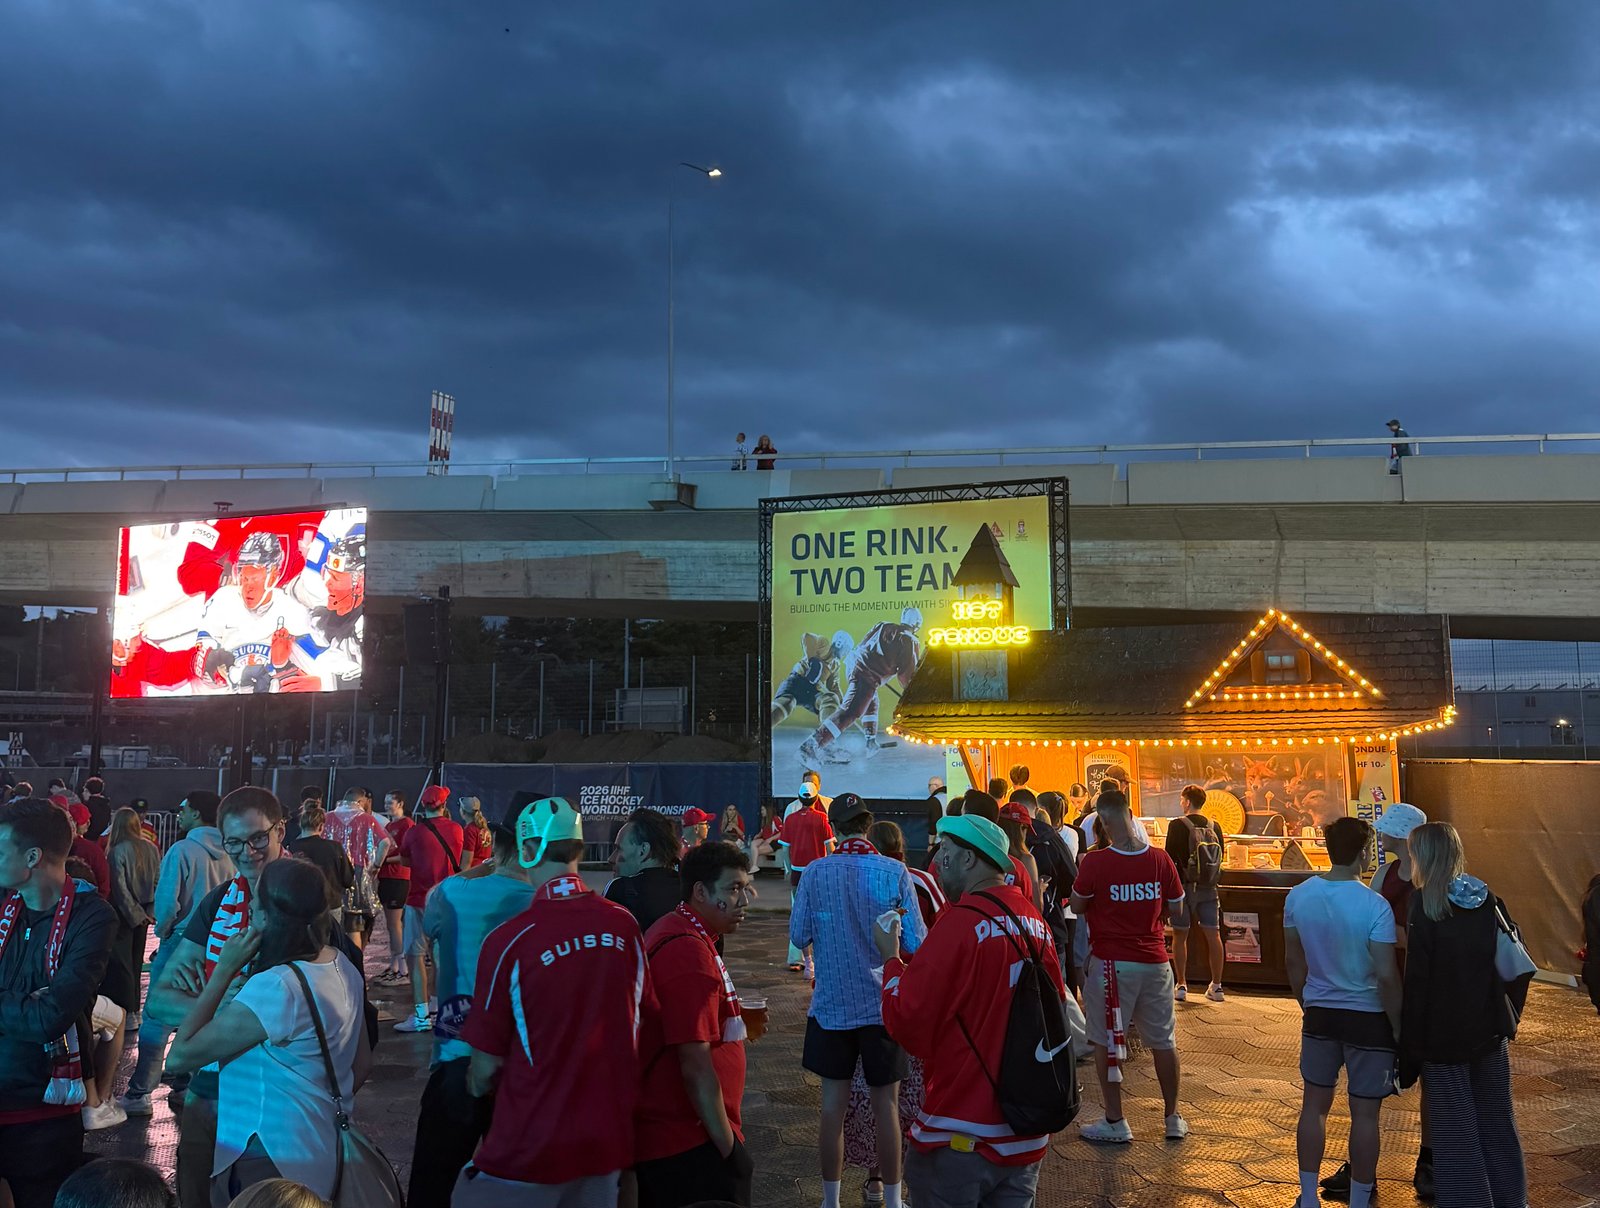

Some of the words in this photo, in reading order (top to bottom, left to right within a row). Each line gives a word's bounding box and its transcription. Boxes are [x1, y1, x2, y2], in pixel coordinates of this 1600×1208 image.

[791, 531, 856, 561] ONE
[866, 525, 959, 557] RINK.
[790, 566, 865, 597] TWO
[874, 562, 956, 593] TEAM
[790, 603, 831, 614] BUILDING
[832, 602, 850, 612] THE
[852, 600, 908, 611] MOMENTUM
[911, 599, 936, 609] WITH
[952, 600, 1003, 620] HOT
[928, 625, 1031, 646] FONDUE
[232, 644, 271, 659] SUOMI
[1354, 745, 1387, 753] ONDUE
[580, 785, 610, 795] 2026
[610, 785, 631, 795] IIHF
[580, 795, 600, 805] ICE
[600, 795, 645, 806] HOCKEY
[581, 804, 621, 815] WORLD
[1110, 881, 1161, 902] SUISSE
[540, 932, 625, 967] SUISSE
